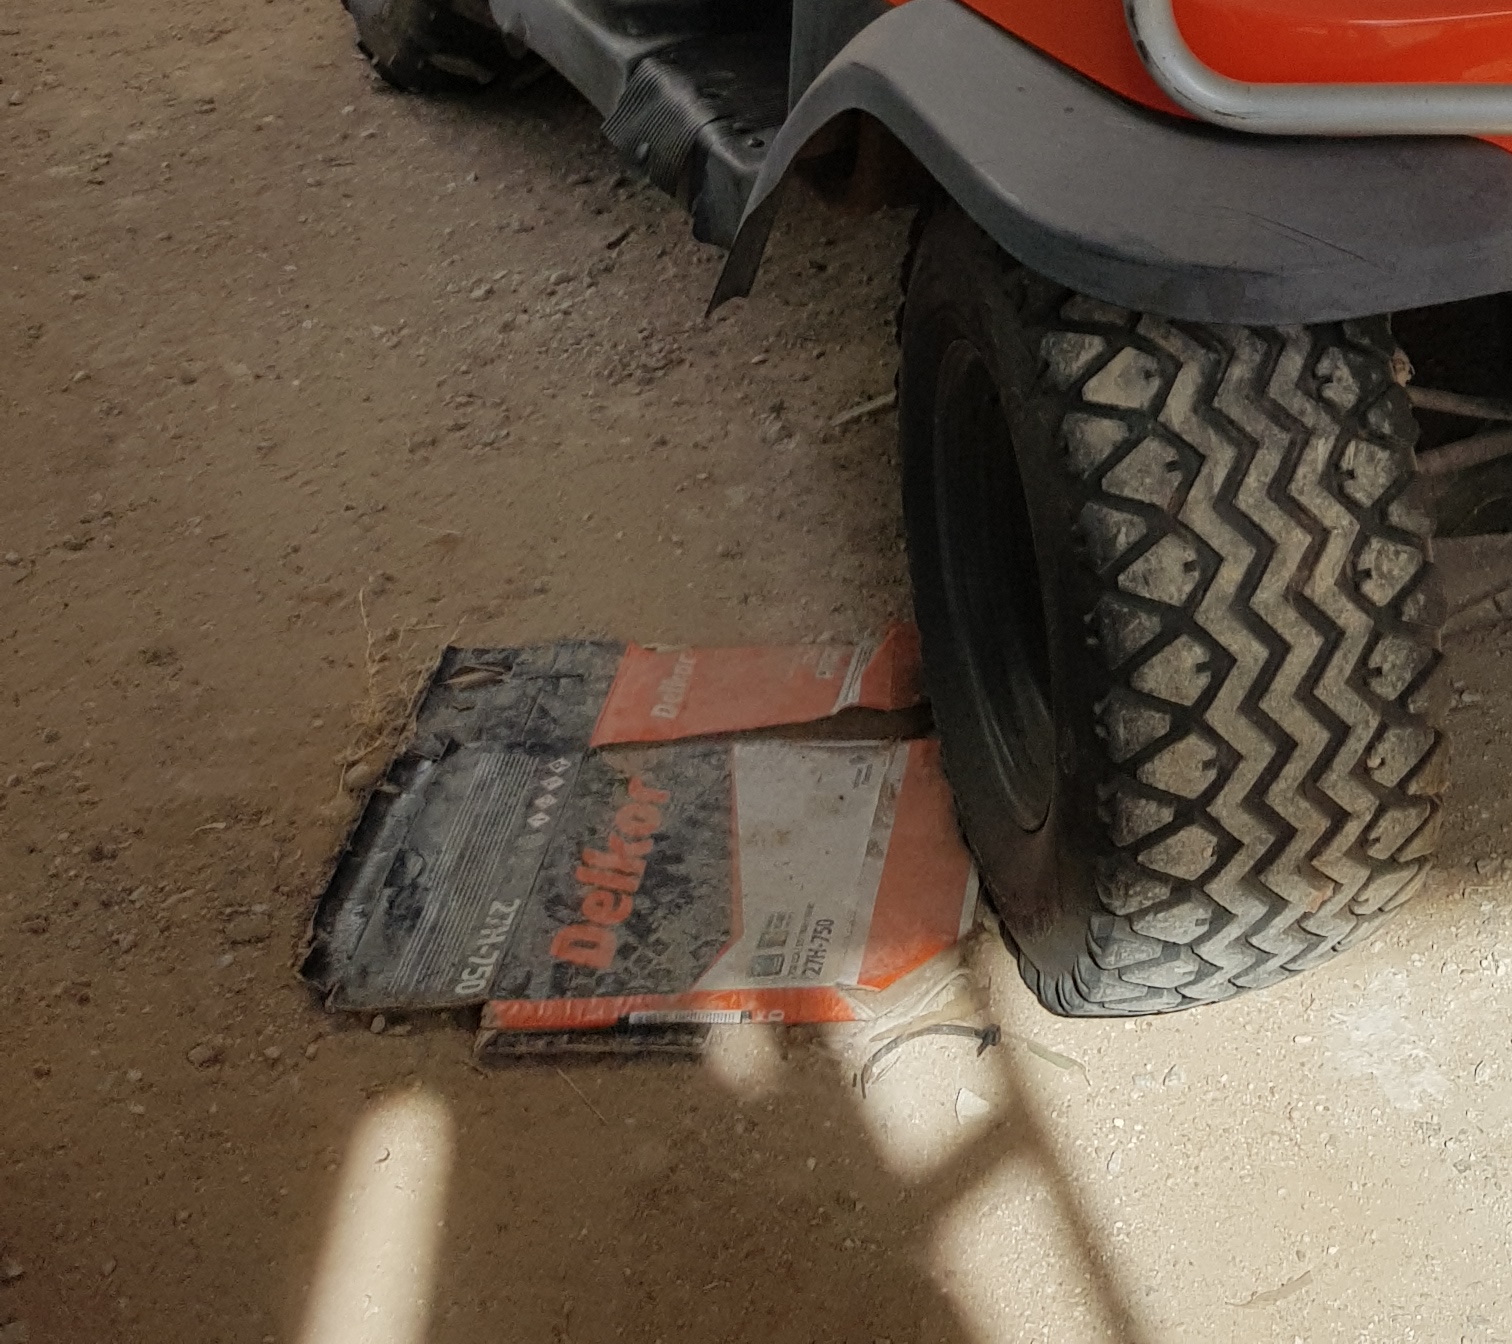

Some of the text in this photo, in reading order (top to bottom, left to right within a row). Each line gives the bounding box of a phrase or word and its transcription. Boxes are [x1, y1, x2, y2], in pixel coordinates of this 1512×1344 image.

[550, 776, 671, 970] Delkor
[454, 899, 520, 994] 27H-750
[801, 919, 834, 976] 27H-750
